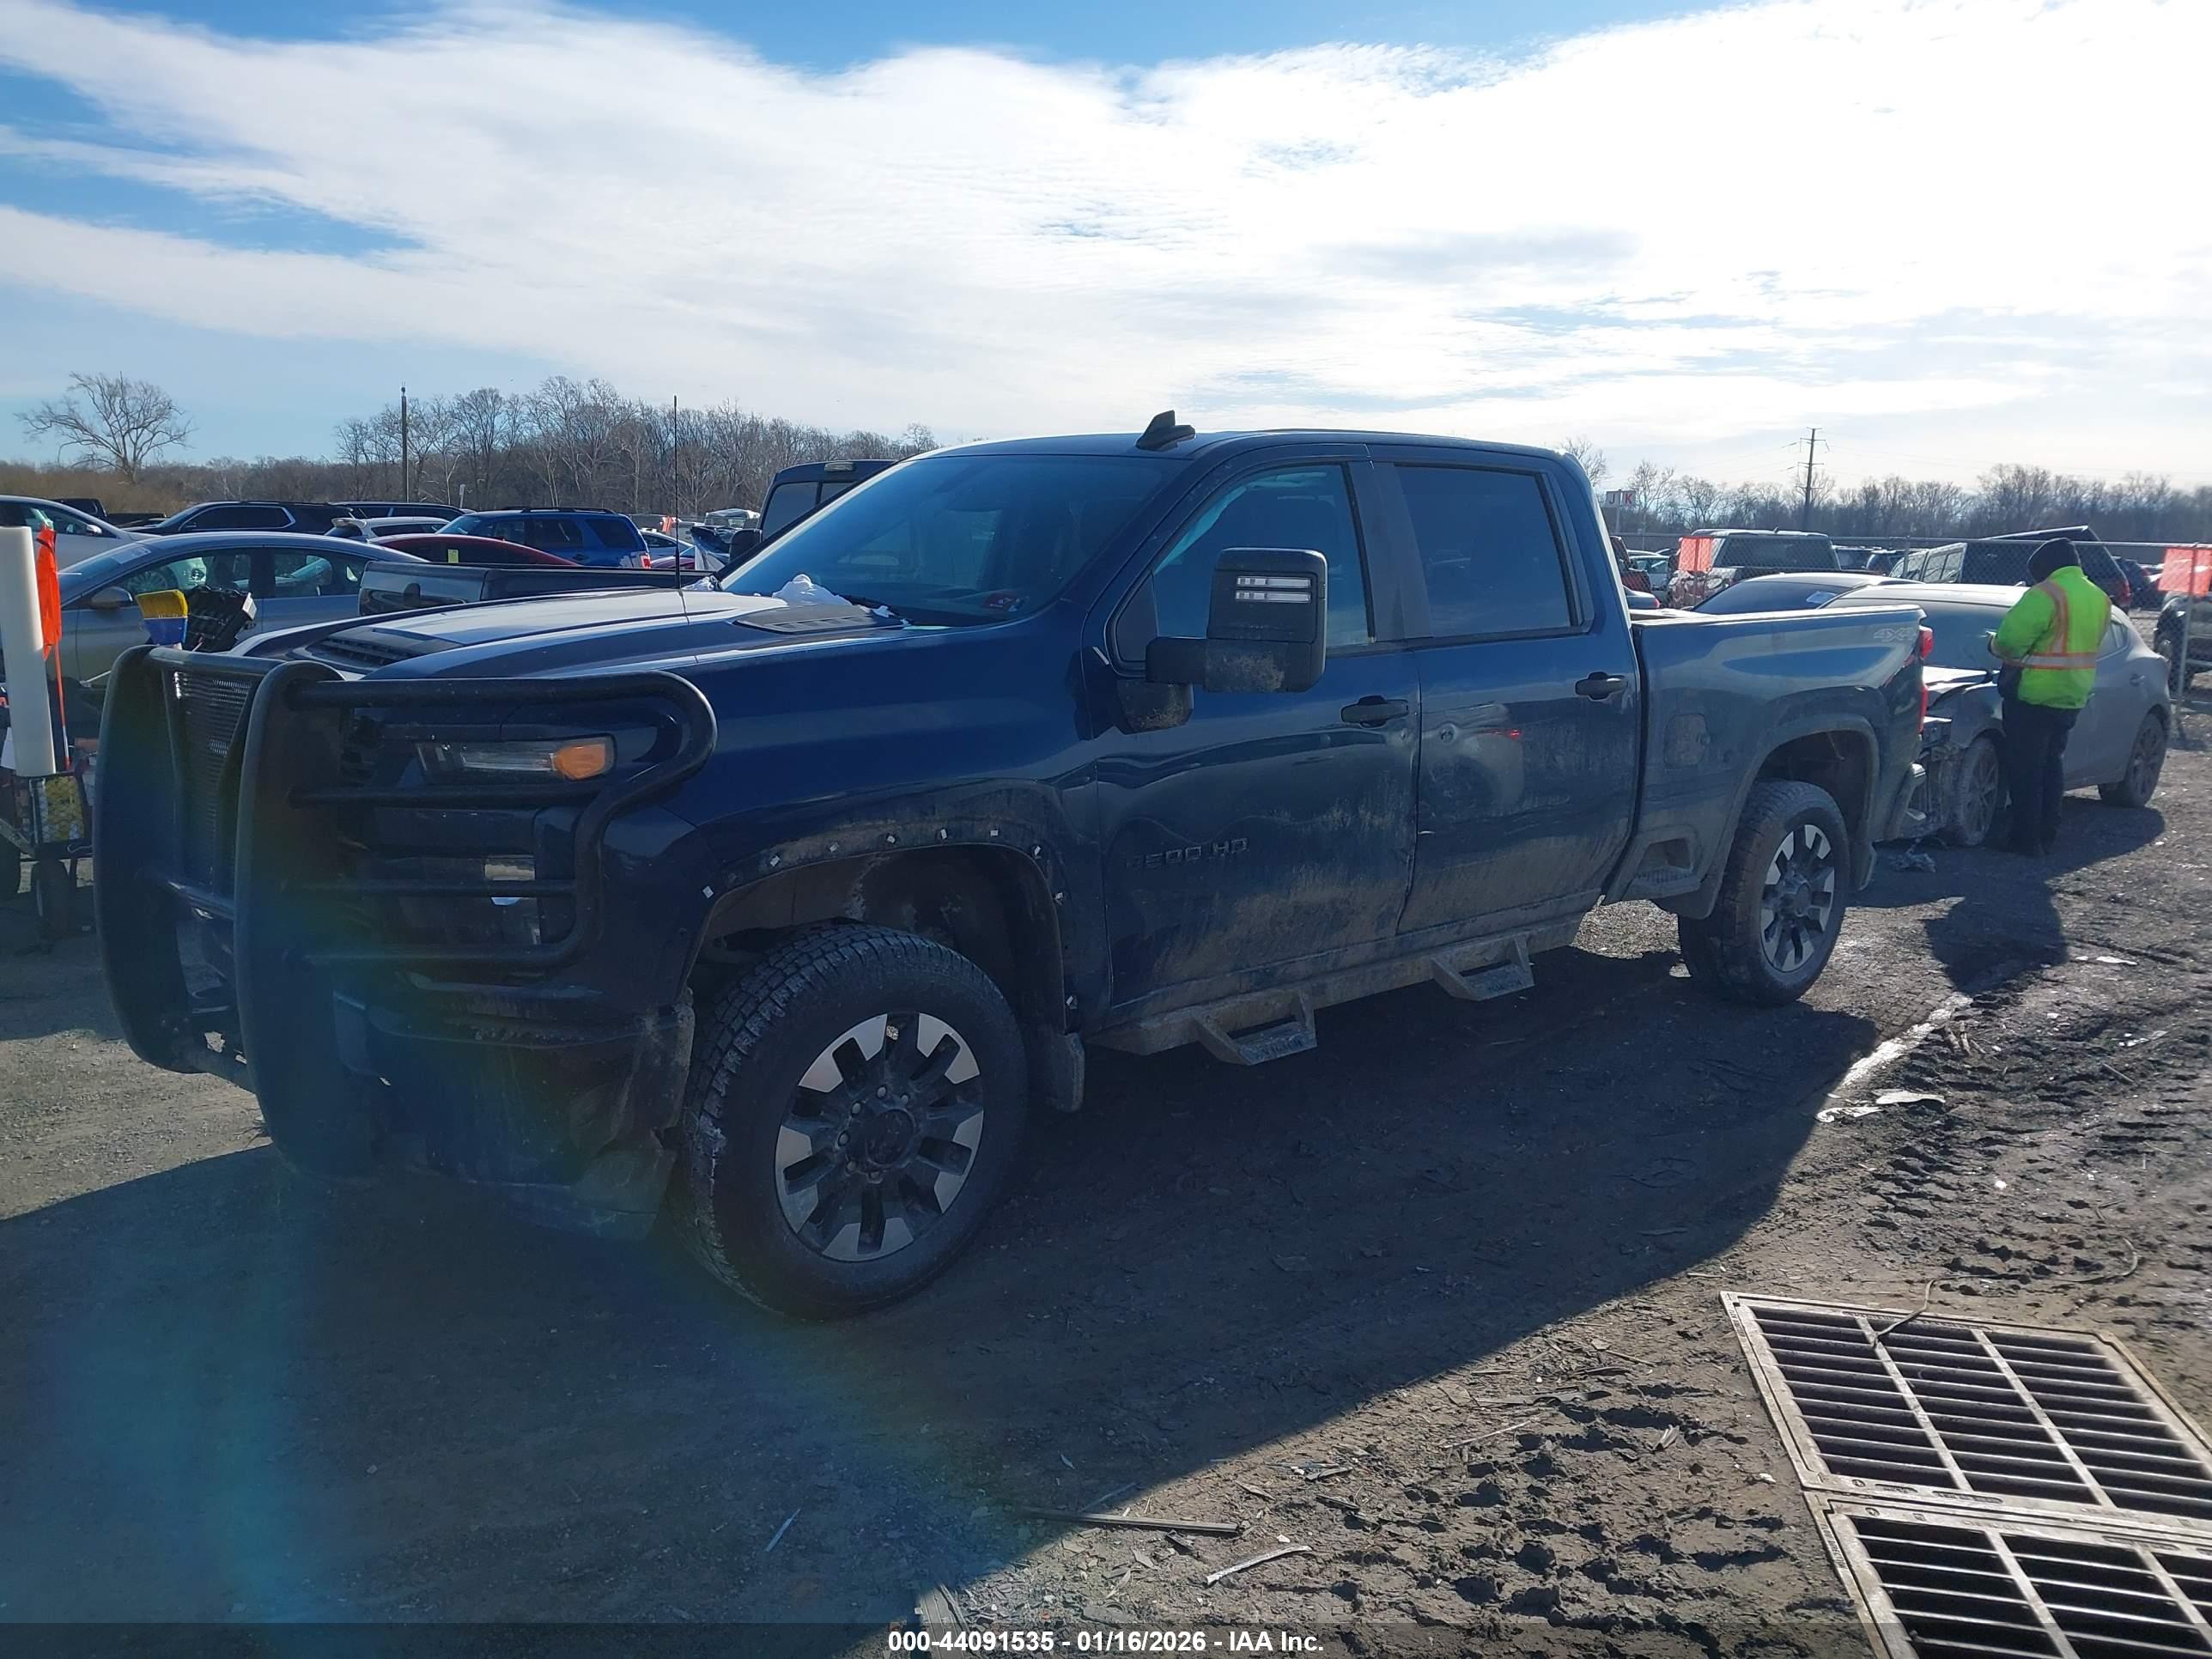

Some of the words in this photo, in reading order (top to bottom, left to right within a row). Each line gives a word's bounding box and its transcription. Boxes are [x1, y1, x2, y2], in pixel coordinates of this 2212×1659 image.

[1625, 493, 1632, 505] K
[1126, 845, 1202, 869] 500
[1212, 837, 1249, 854] HD
